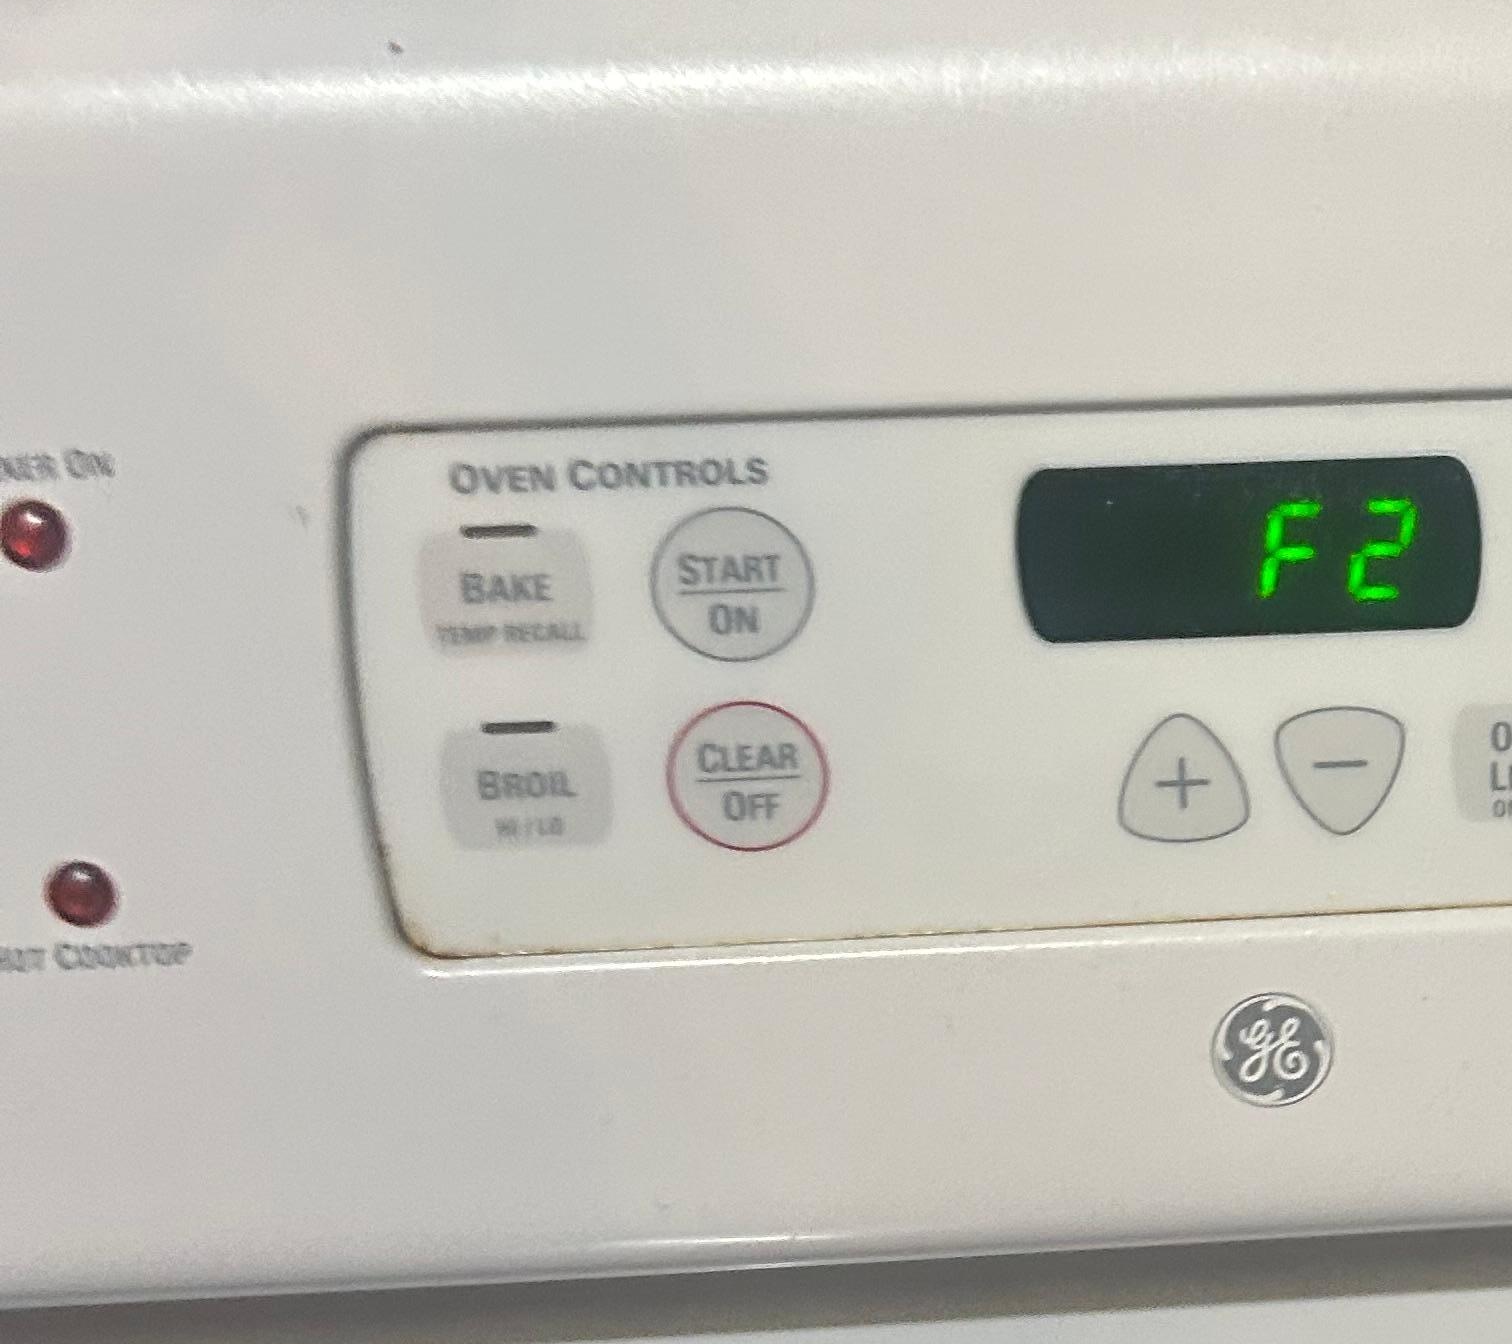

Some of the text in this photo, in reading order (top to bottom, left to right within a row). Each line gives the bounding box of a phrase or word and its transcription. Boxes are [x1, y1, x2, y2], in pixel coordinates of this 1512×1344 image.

[449, 457, 770, 495] OVEN CONTROLS
[1255, 498, 1419, 605] F2
[676, 553, 781, 587] START
[460, 571, 554, 604] BAKE
[708, 603, 760, 636] ON
[696, 742, 799, 774] CLEAR
[476, 770, 577, 801] BROIL
[721, 791, 781, 823] OFF
